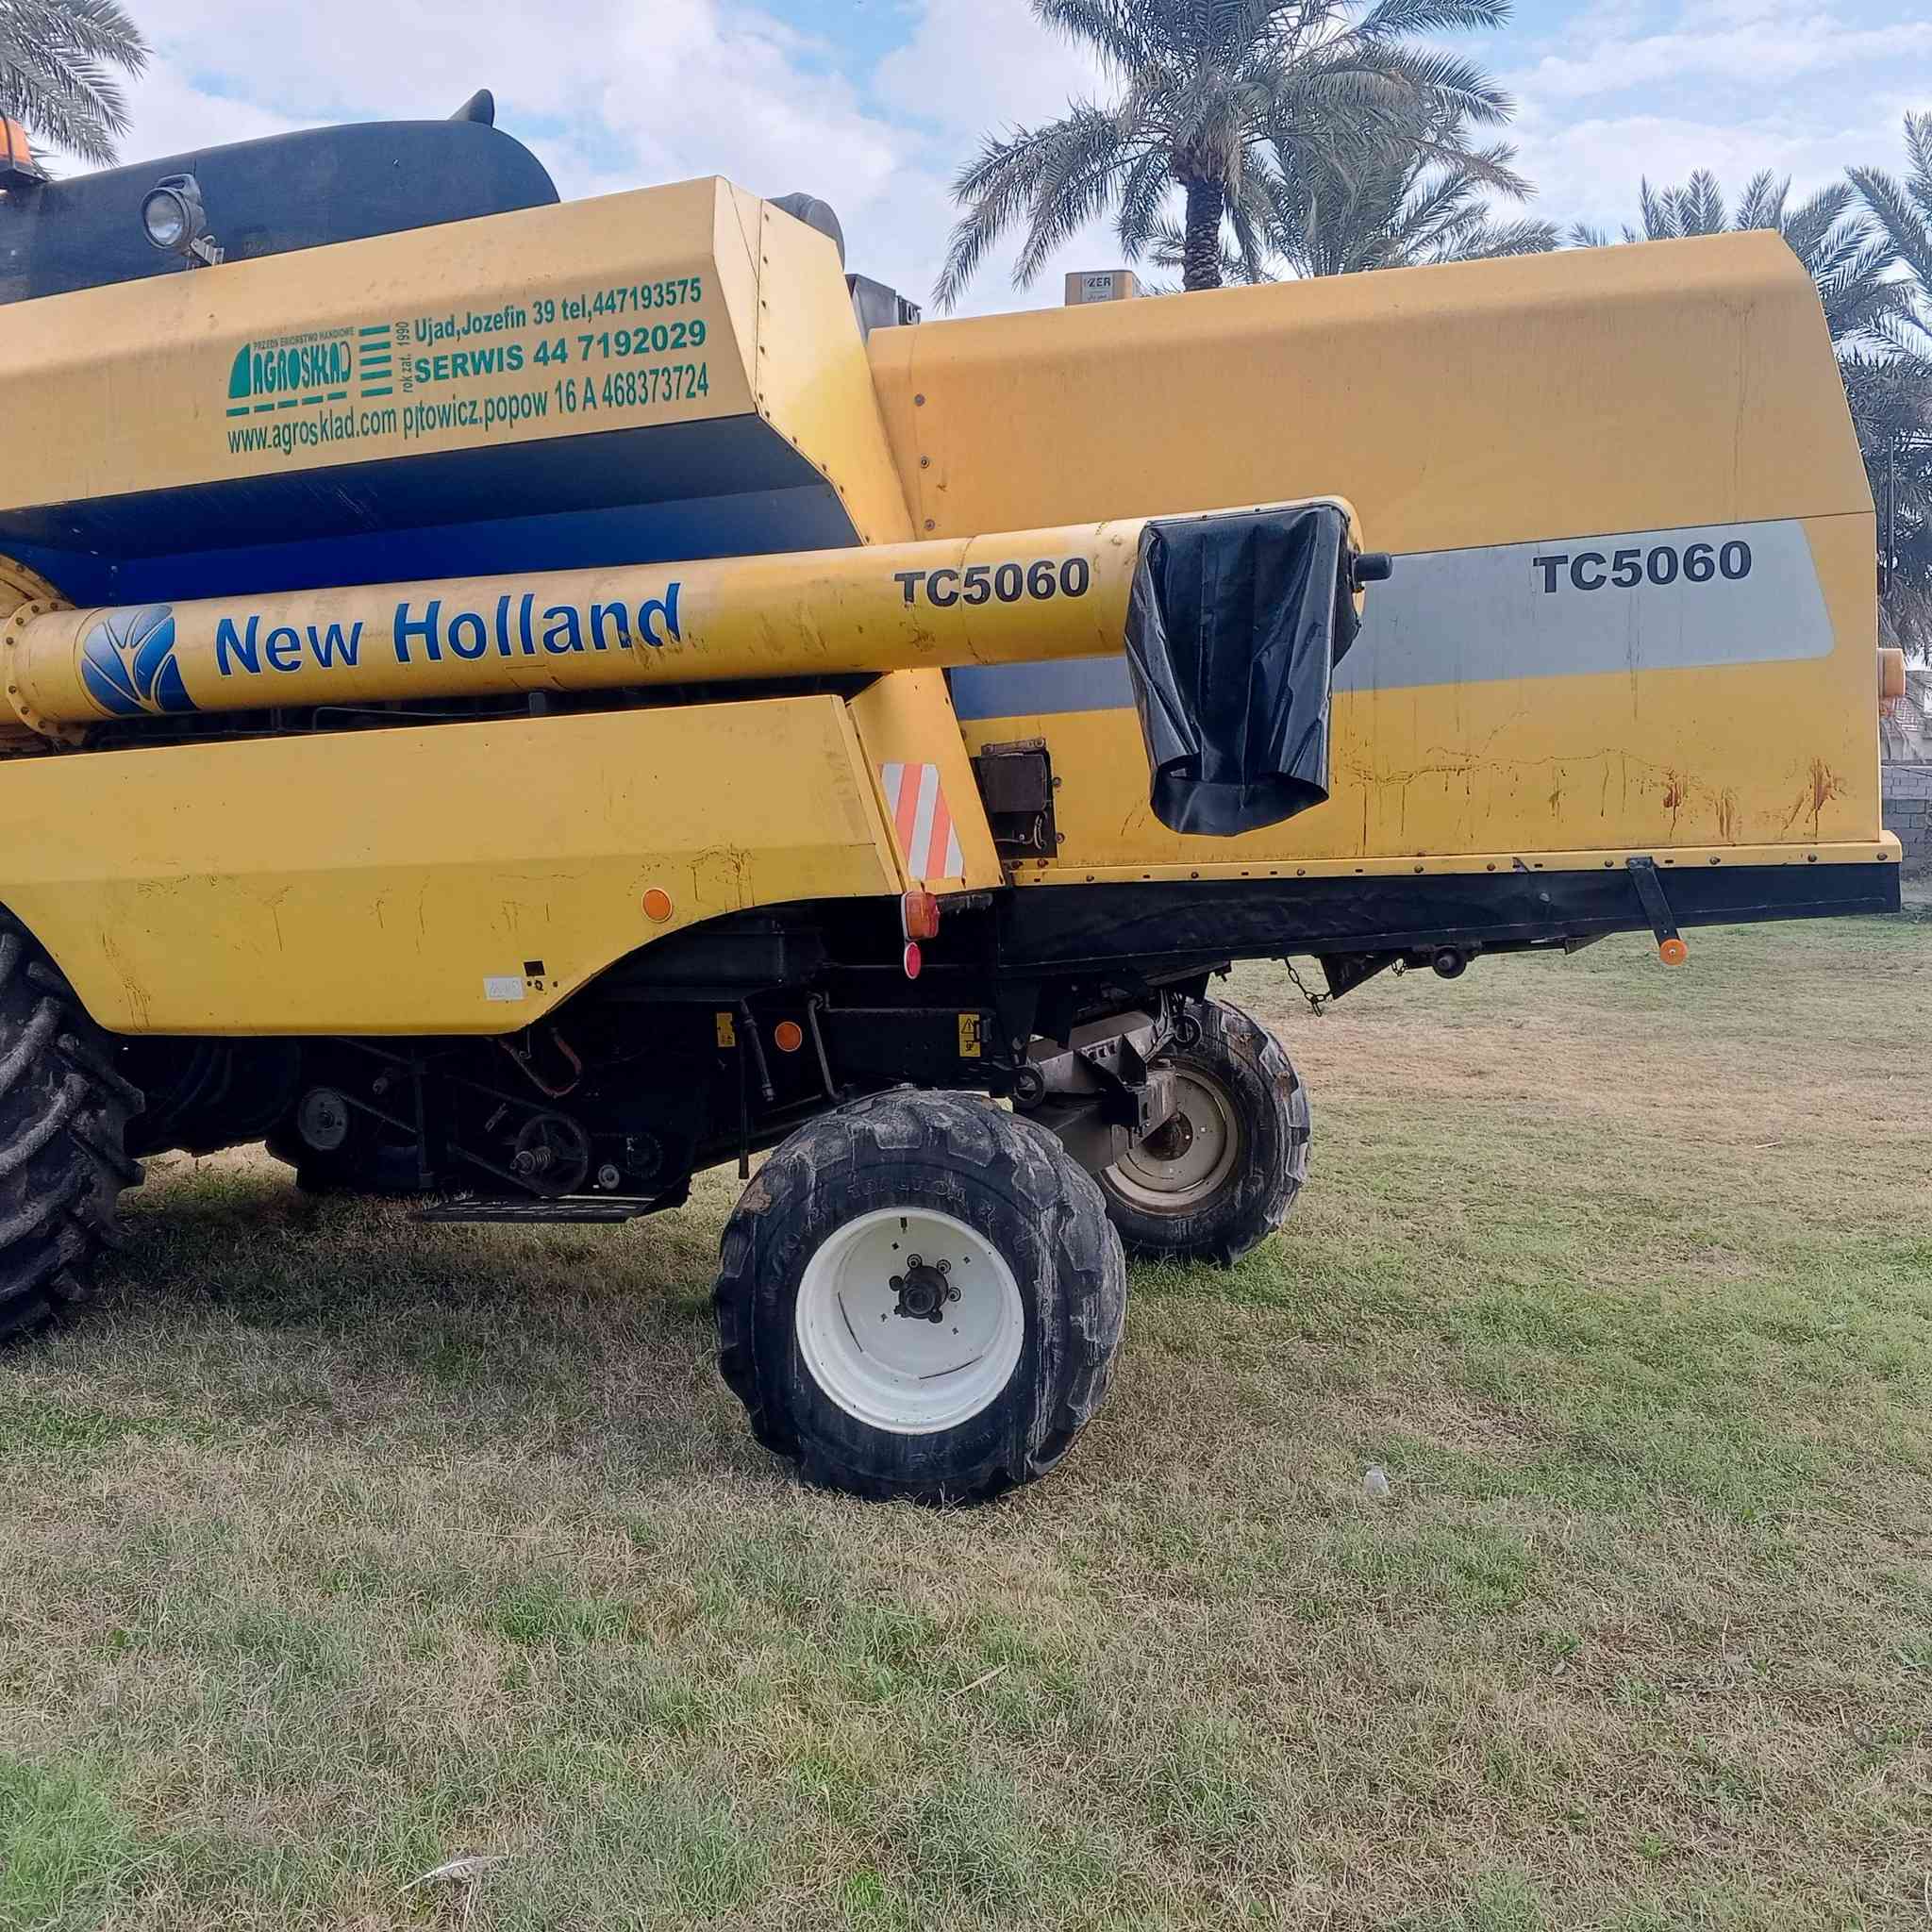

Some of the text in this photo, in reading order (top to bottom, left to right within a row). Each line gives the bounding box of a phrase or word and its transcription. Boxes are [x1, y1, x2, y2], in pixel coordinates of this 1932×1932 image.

[394, 321, 410, 347] 1990
[532, 299, 556, 325] 39
[414, 319, 707, 383] SERWIS 44 7192029
[227, 406, 397, 455] www.agrosklad.com
[555, 377, 577, 414] 16
[582, 376, 597, 411] A
[602, 361, 709, 408] 468373724
[398, 375, 413, 392] rok
[894, 558, 1090, 607] TC5060
[1533, 540, 1752, 593] TC5060
[216, 582, 682, 676] New Holland
